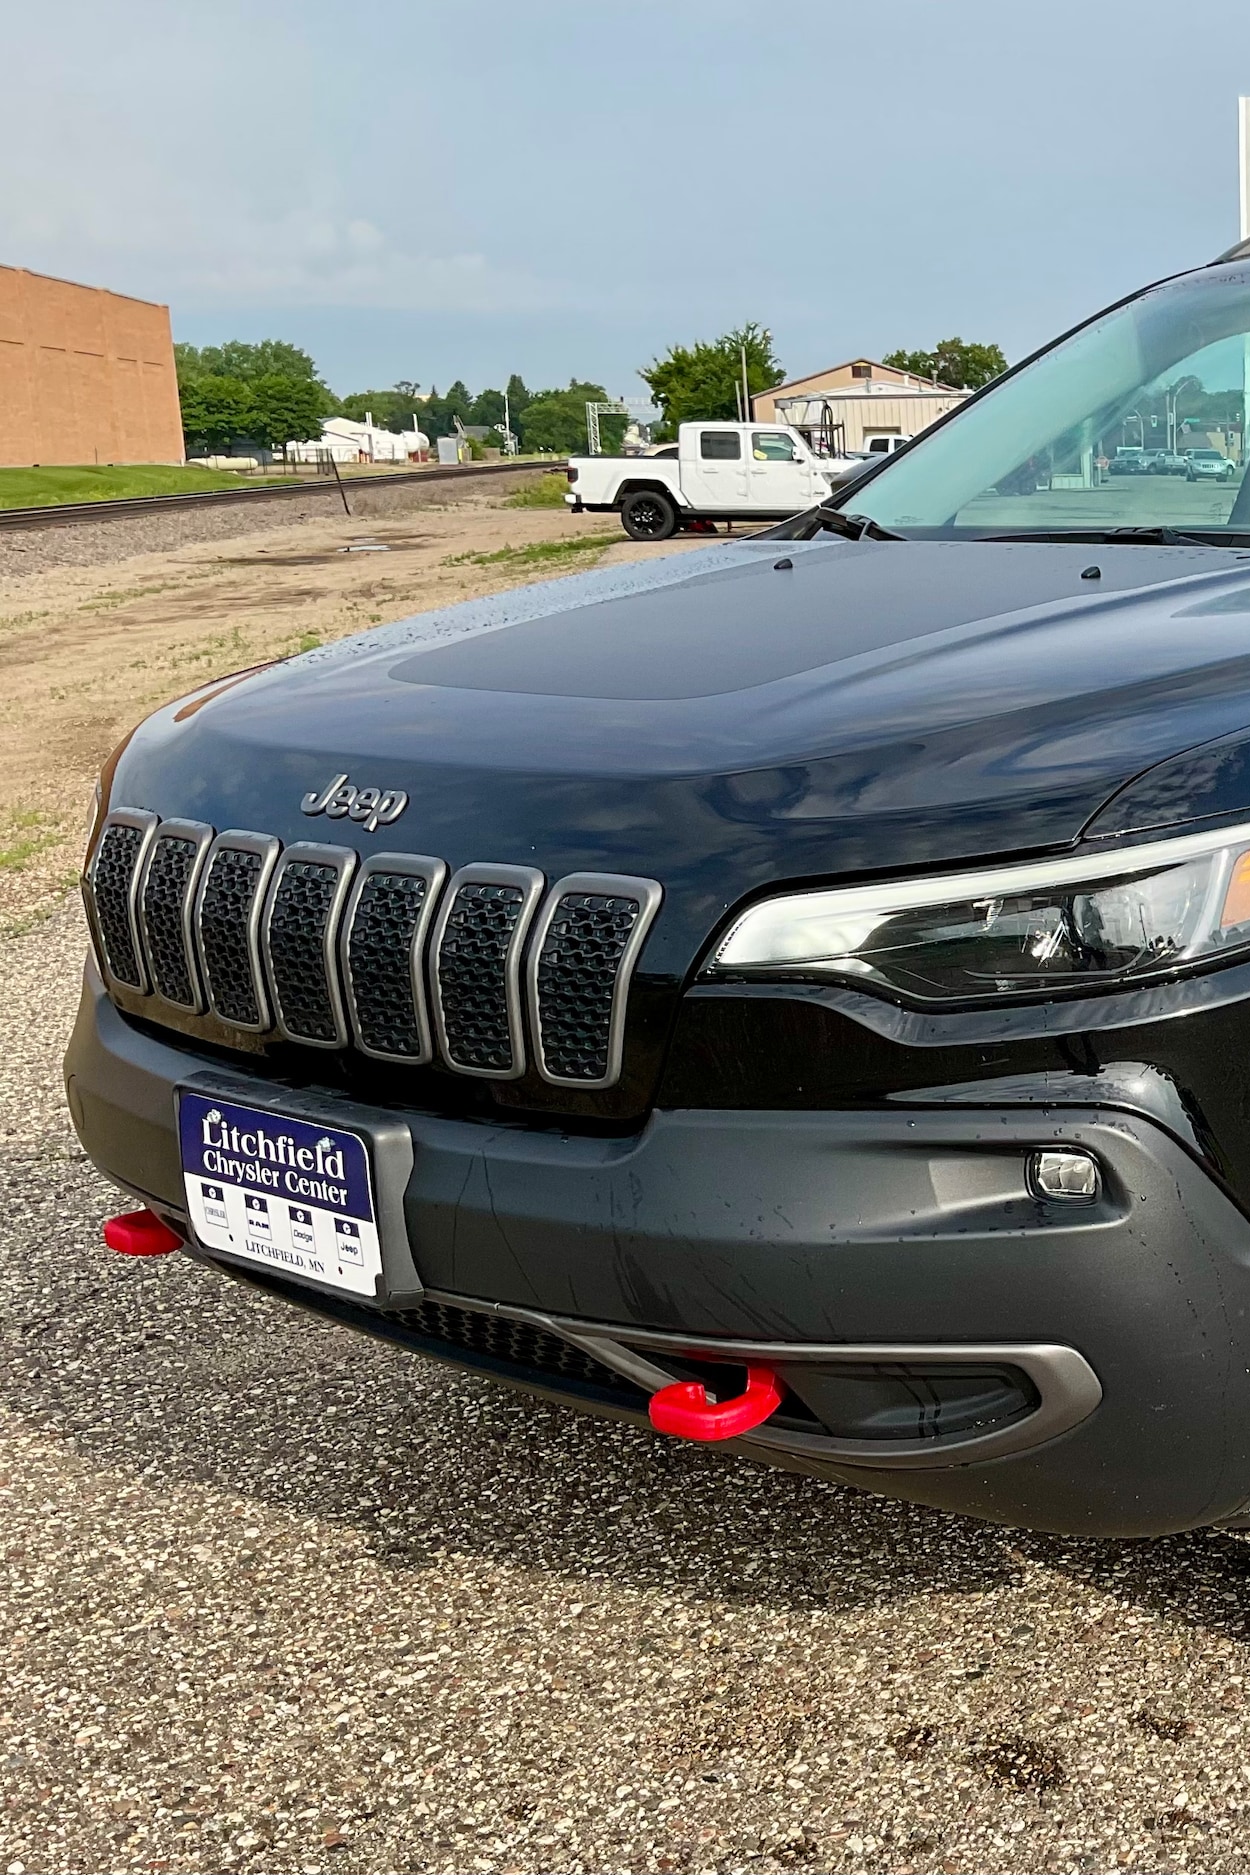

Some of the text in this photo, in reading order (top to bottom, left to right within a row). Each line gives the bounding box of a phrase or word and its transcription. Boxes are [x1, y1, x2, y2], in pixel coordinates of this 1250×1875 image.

[300, 773, 408, 832] Jeep
[202, 1117, 346, 1181] Litchfield
[203, 1149, 348, 1207] Chrysler Center
[245, 1239, 325, 1274] LITCHFIELD, MN
[293, 1229, 313, 1243] Dodge
[340, 1242, 359, 1256] Jeep
